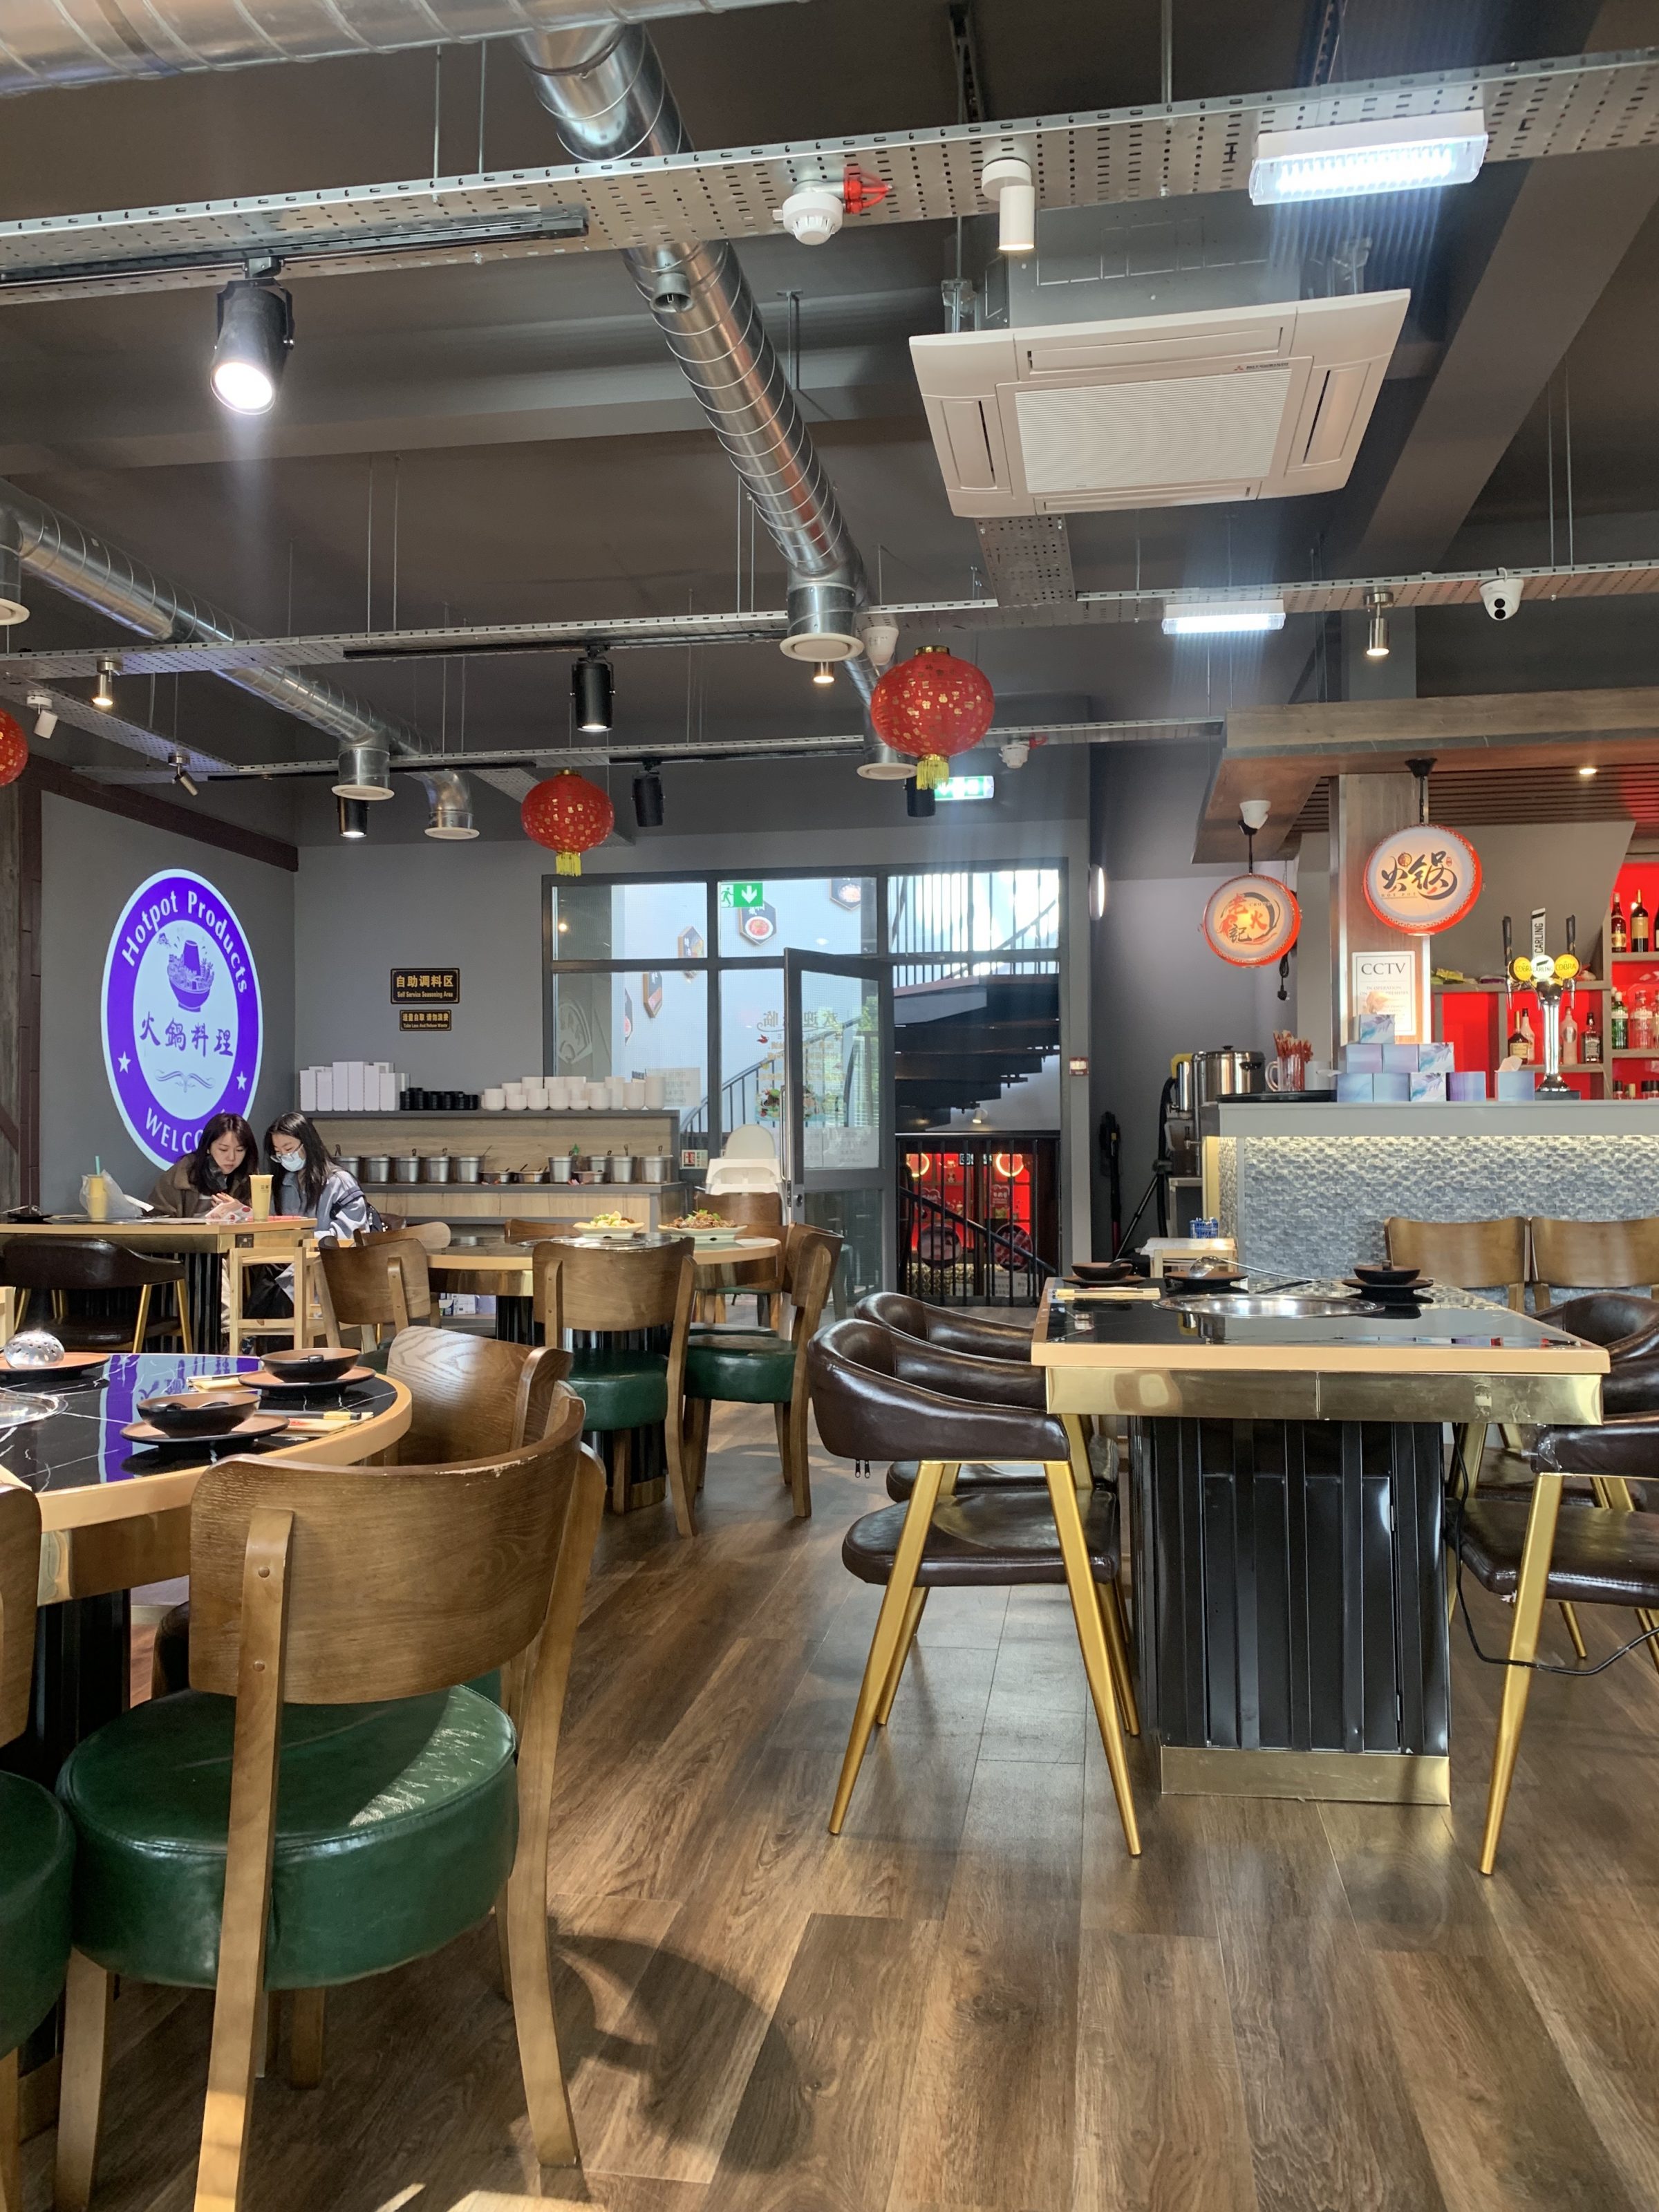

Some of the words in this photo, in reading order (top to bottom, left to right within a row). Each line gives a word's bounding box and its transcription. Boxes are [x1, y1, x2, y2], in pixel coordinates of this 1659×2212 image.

[122, 890, 178, 967] Hotpot
[188, 890, 247, 993] Products
[1534, 923, 1544, 953] CARLING
[396, 975, 454, 988] 自助调料区
[1361, 963, 1405, 975] CCTV
[1555, 963, 1576, 971] COBRA
[139, 1011, 234, 1058] 火鍋料理
[146, 1107, 204, 1154] WELCO
